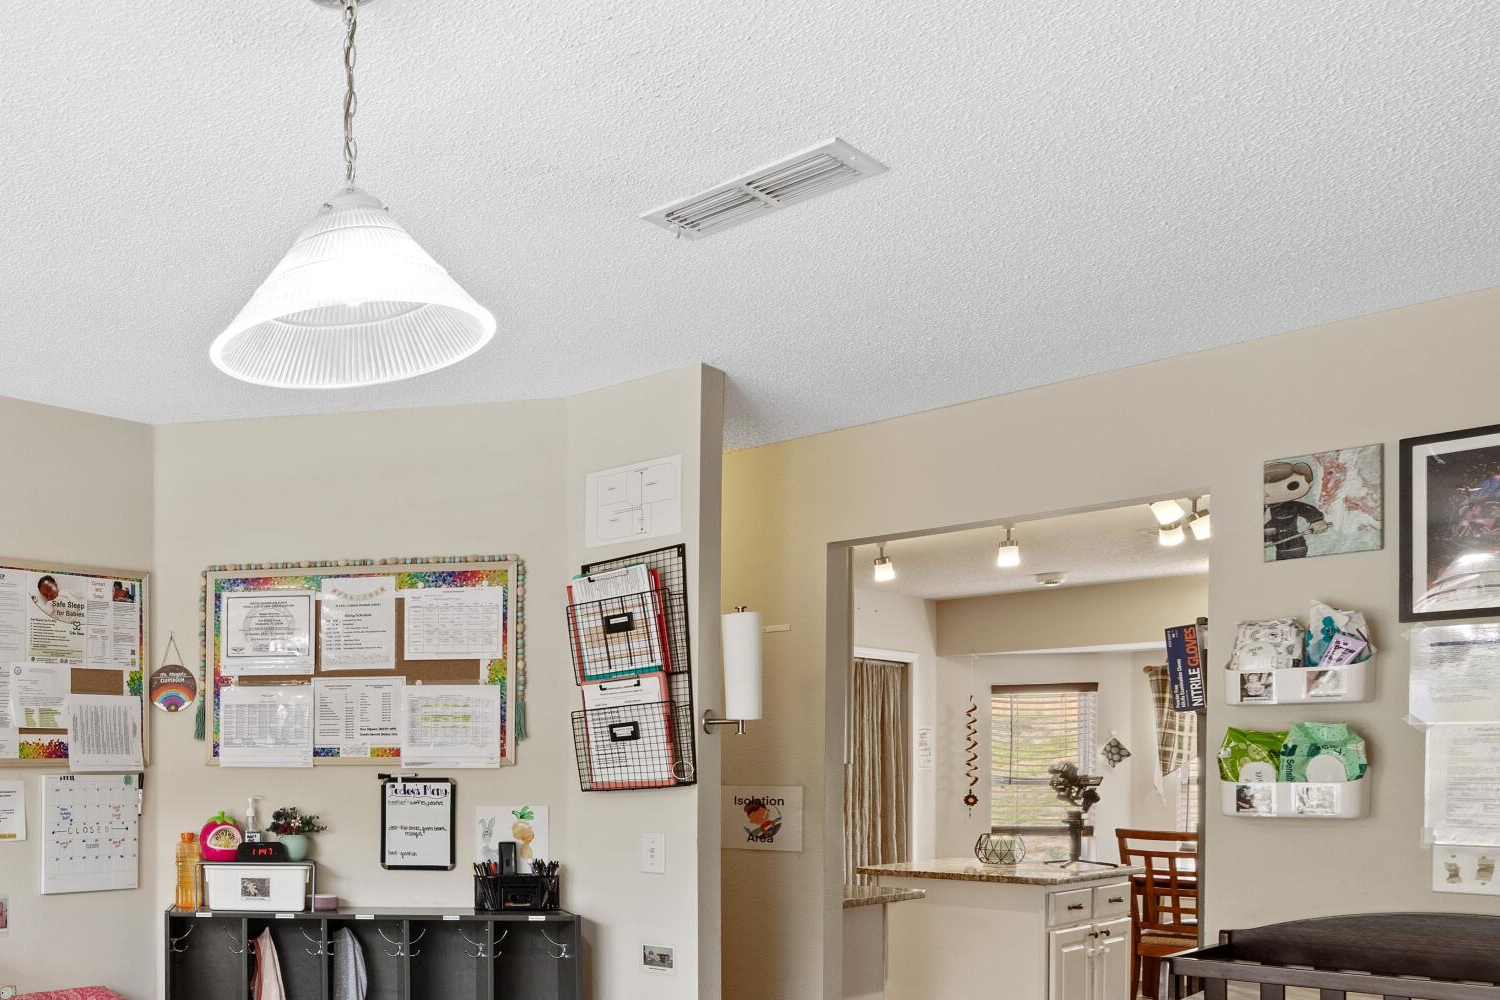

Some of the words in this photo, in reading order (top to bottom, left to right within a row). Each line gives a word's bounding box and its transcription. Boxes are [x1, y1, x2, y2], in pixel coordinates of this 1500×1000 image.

[51, 600, 66, 608] Safe
[67, 601, 85, 611] Sleep
[66, 610, 85, 618] Babies
[1184, 626, 1200, 667] GLOVES
[1188, 667, 1204, 707] NITRILE
[388, 783, 421, 798] Today's
[733, 795, 785, 808] Isolation
[746, 832, 774, 845] Area
